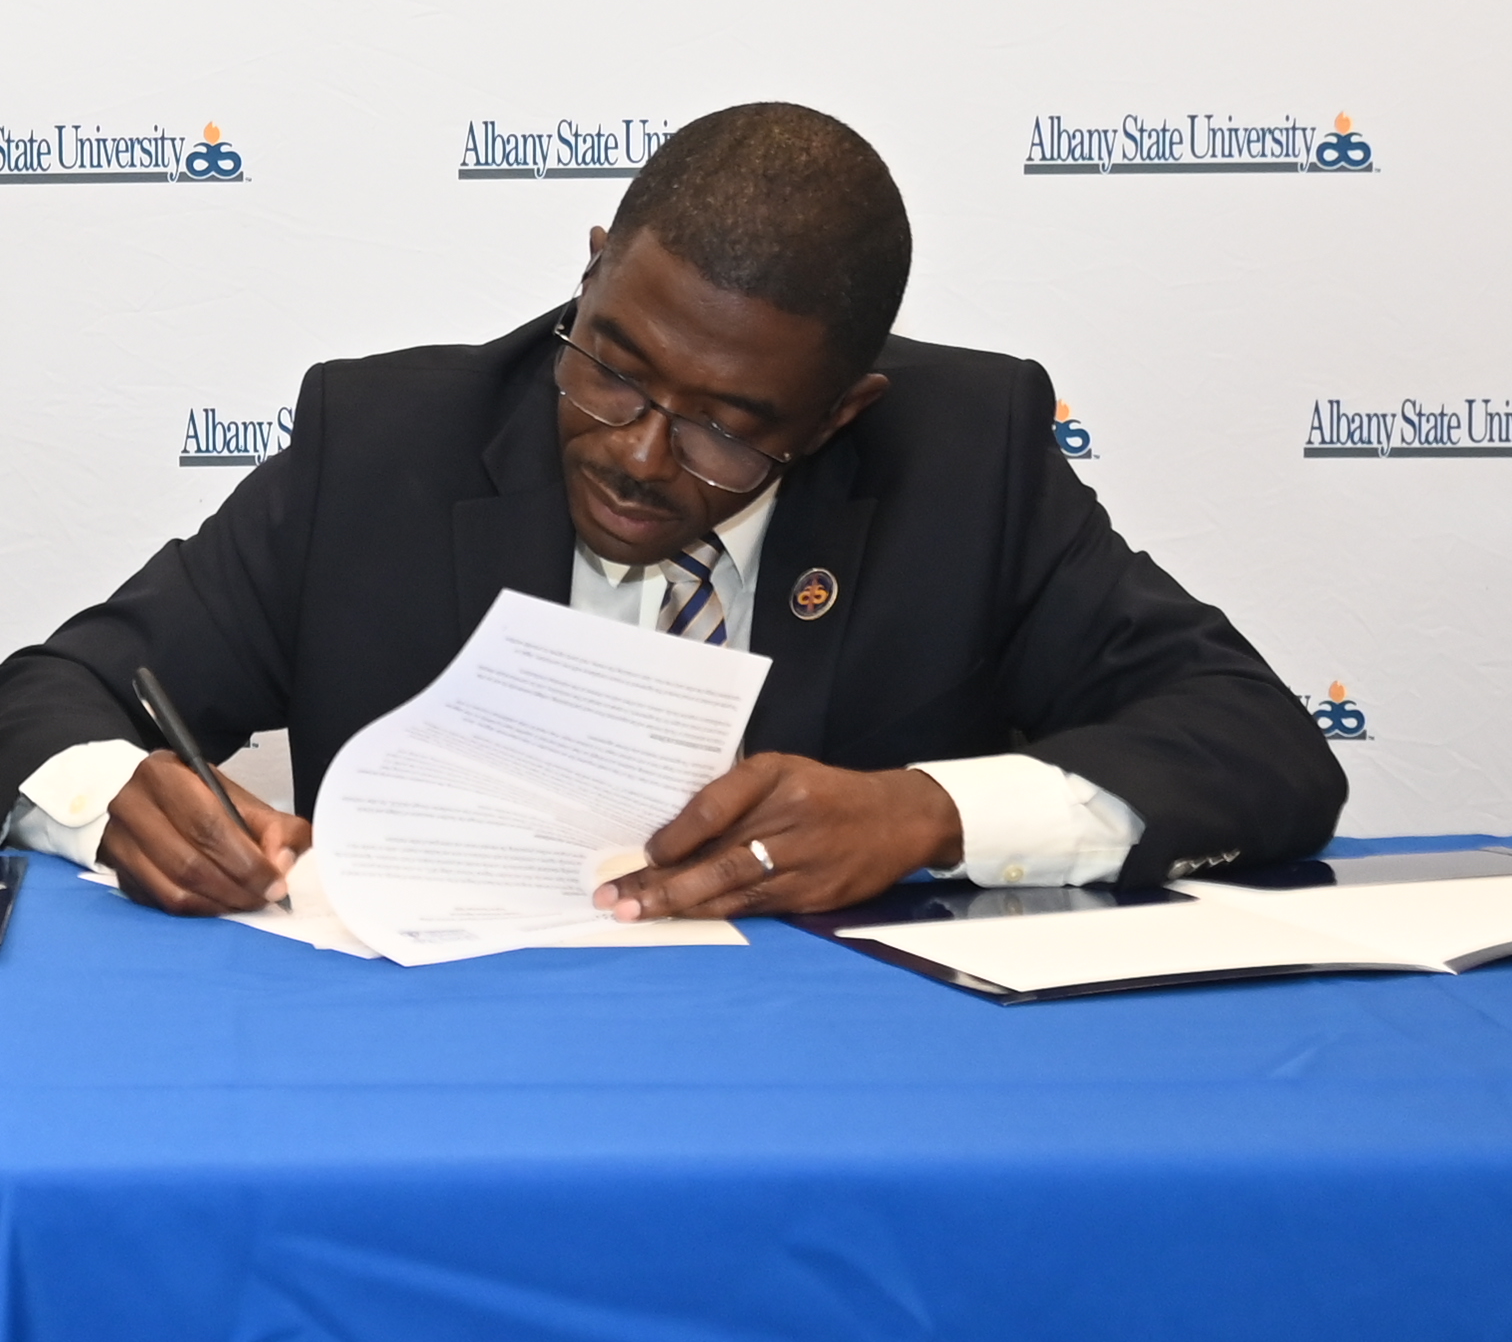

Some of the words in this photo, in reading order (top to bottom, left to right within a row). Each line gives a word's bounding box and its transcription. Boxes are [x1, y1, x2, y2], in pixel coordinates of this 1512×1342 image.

[55, 124, 185, 182] University
[460, 120, 553, 177] Albany
[557, 118, 619, 167] State
[1027, 115, 1118, 173] Albany
[1121, 113, 1183, 162] State
[1187, 113, 1316, 172] University
[180, 408, 273, 465] Albany
[1306, 399, 1396, 457] Albany
[1400, 397, 1461, 446] State
